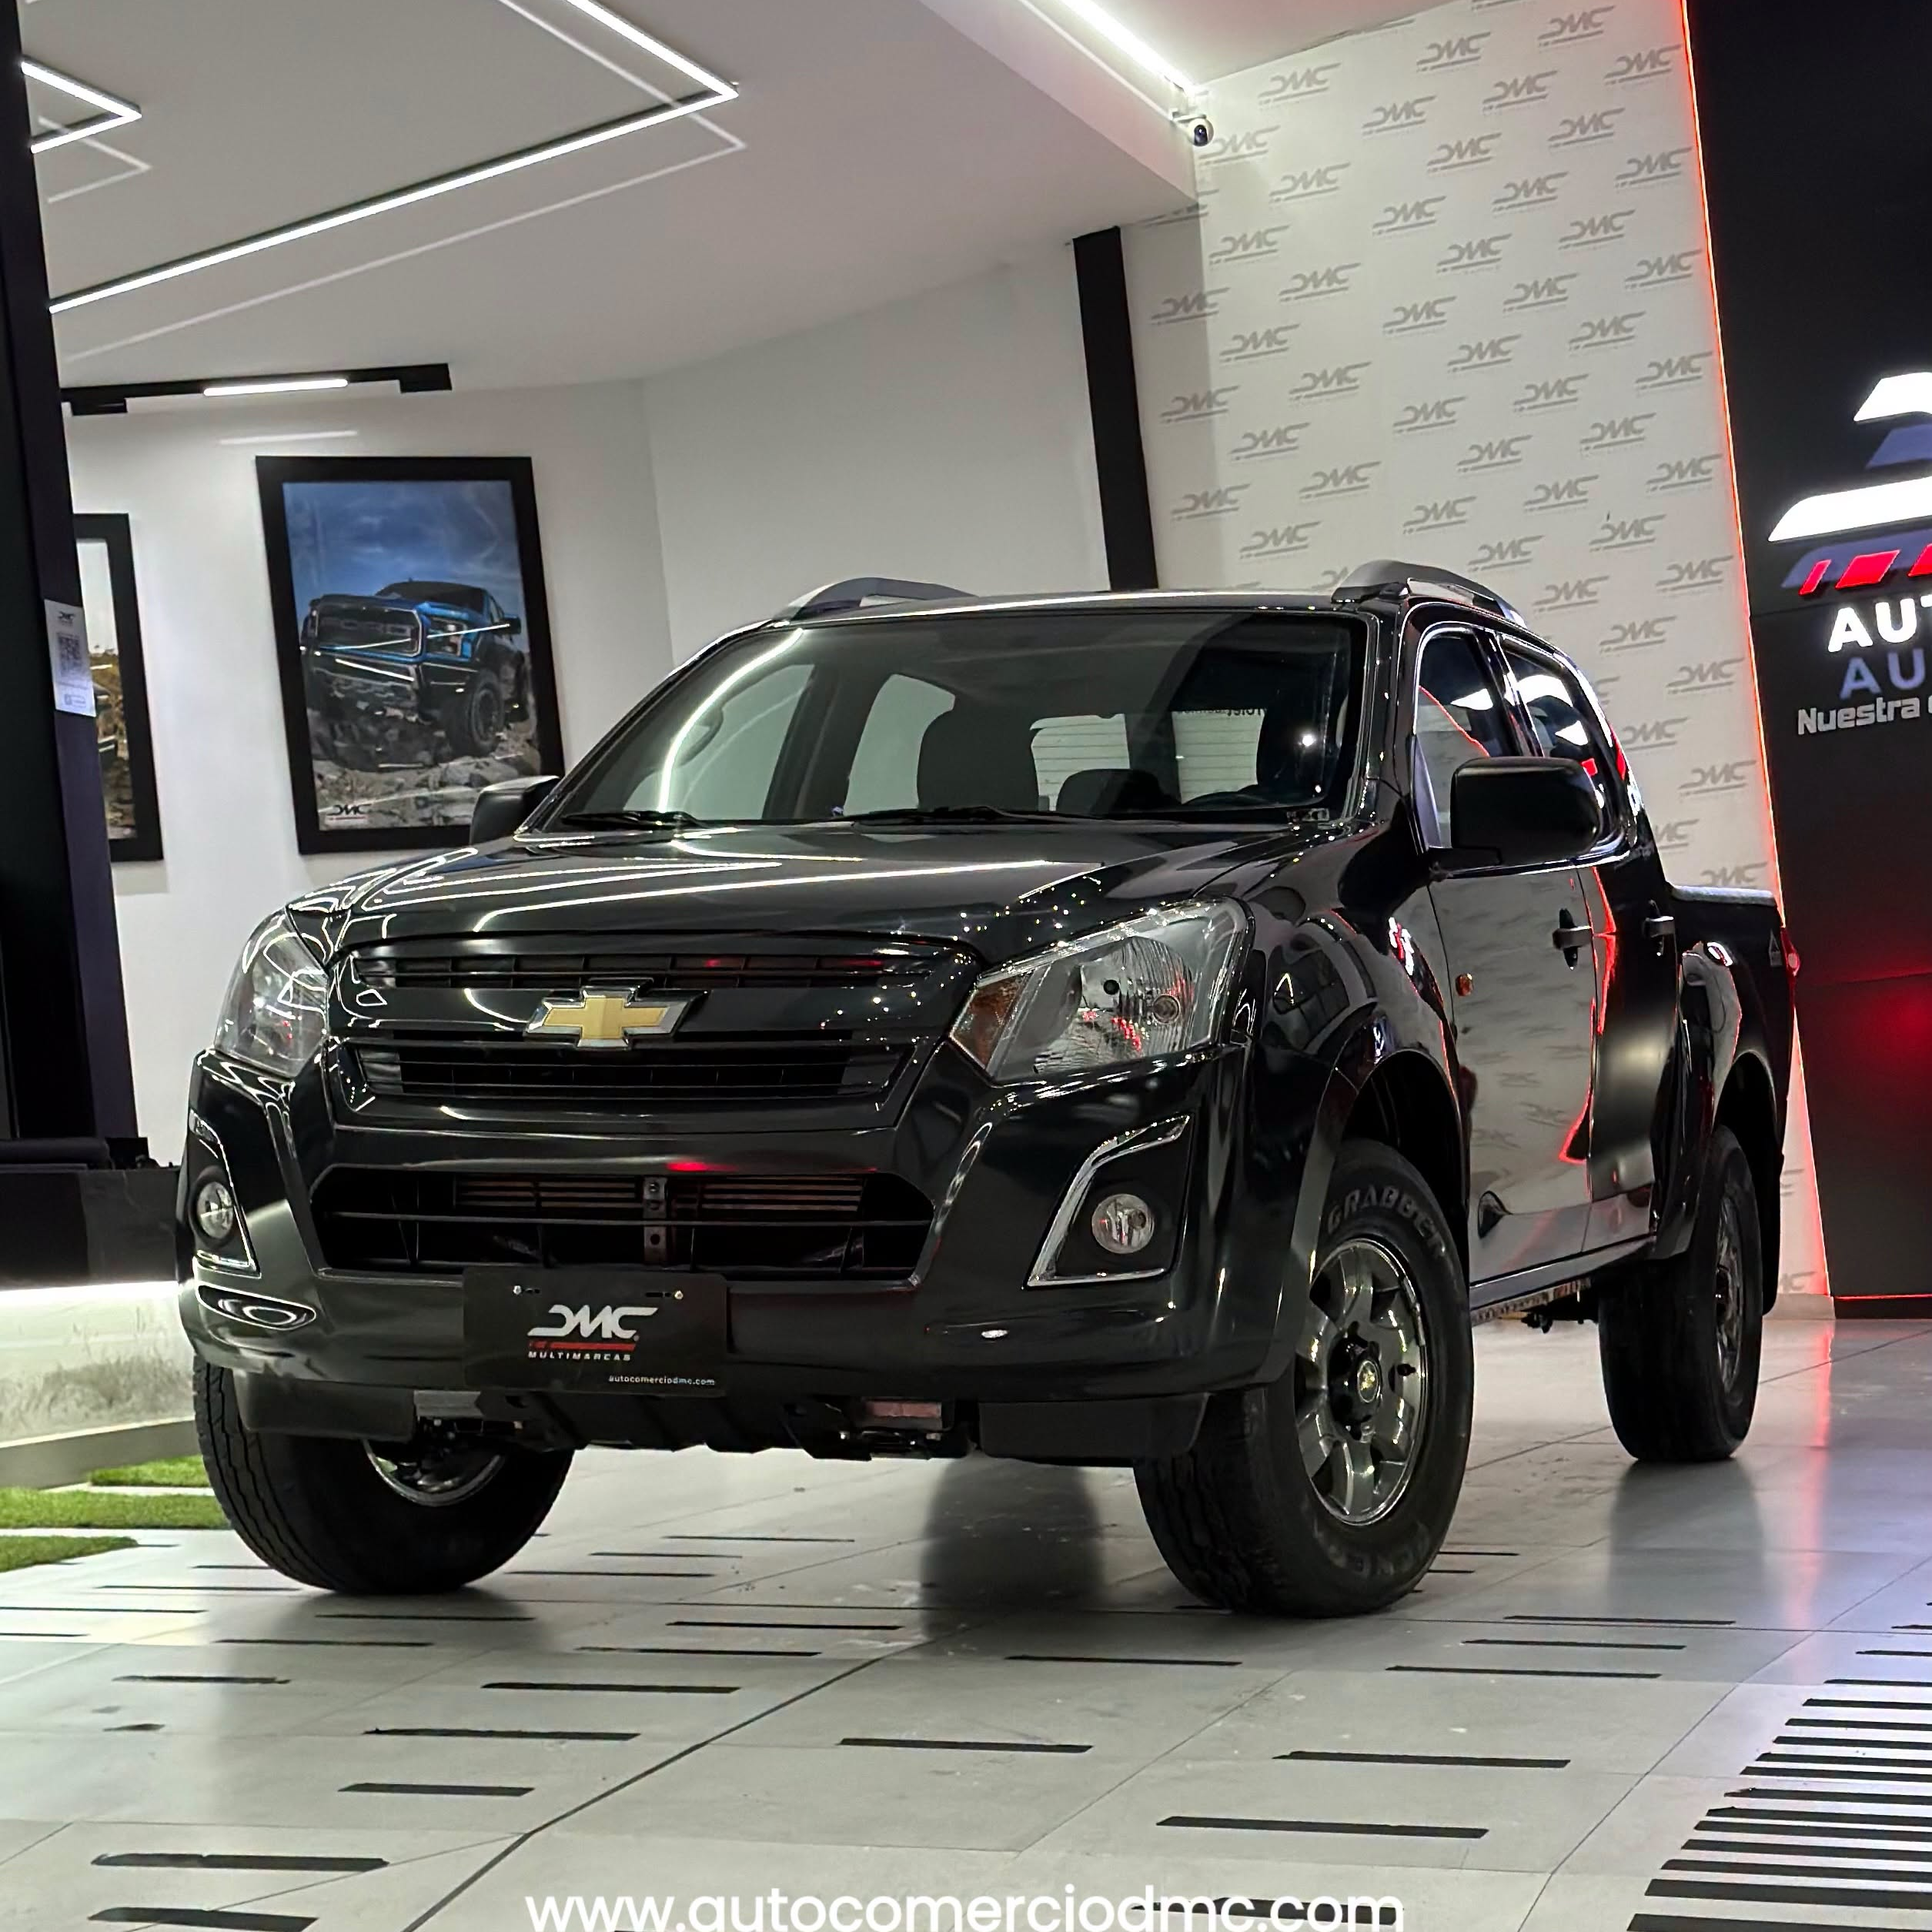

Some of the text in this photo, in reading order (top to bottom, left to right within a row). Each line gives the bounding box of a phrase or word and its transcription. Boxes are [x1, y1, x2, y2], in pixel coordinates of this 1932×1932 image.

[1798, 697, 1920, 735] Nuestra
[528, 1350, 631, 1362] MULTIMARCAS
[608, 1374, 716, 1386] autocomerciodmc.com
